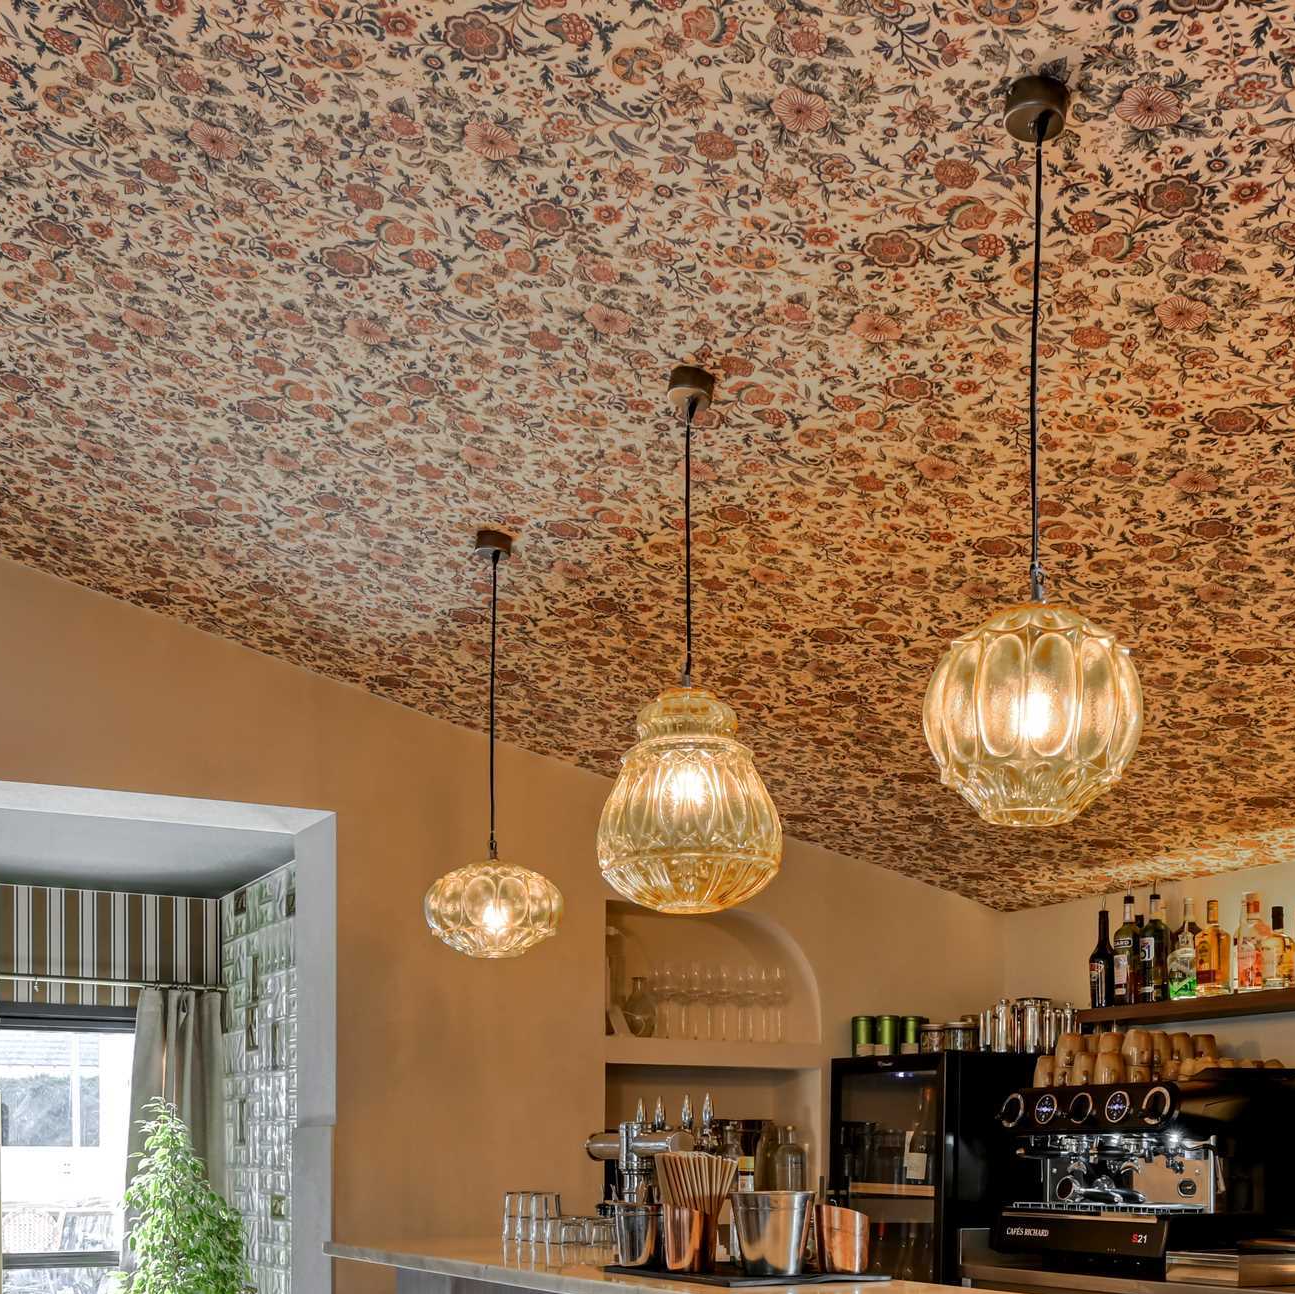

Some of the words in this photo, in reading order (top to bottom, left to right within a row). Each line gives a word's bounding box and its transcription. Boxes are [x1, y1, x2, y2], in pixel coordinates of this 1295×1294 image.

[1140, 944, 1151, 960] 51
[1006, 1226, 1024, 1236] CAFÉS
[1024, 1228, 1050, 1238] RICHARD
[1131, 1233, 1148, 1244] S21
